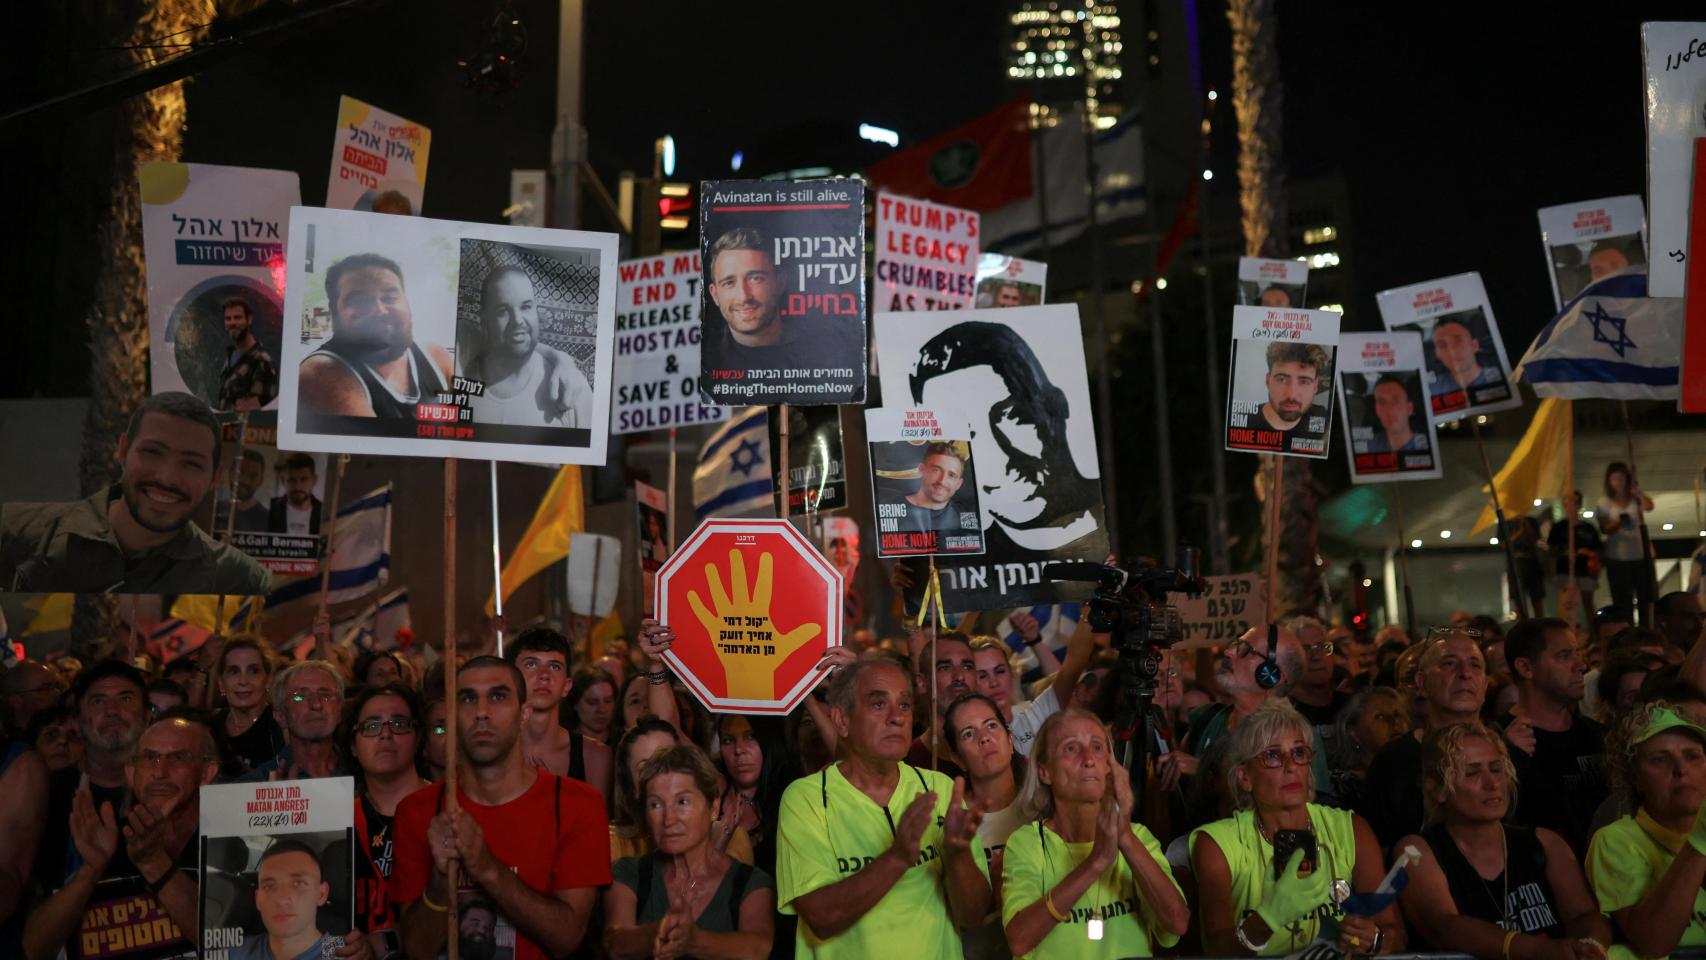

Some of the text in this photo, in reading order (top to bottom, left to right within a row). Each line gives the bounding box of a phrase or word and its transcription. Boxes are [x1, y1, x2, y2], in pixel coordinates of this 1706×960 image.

[350, 123, 381, 151] אהל
[385, 140, 416, 163] אלון
[340, 166, 377, 189] בחיים
[713, 189, 851, 203] Avinatan is still alive.
[881, 198, 977, 238] TRUMP'S
[172, 213, 280, 243] אלון אהל
[186, 245, 247, 262] שיחזור
[774, 236, 857, 266] אבינתן
[888, 230, 969, 265] LEGACY
[620, 260, 665, 283] WAR
[798, 263, 857, 292] עדיין
[877, 260, 976, 297] CRUMBLES
[633, 283, 676, 305] END
[780, 293, 858, 316] בחיים.
[617, 304, 692, 330] RELEASE
[620, 326, 702, 355] HOSTAG
[665, 354, 679, 373] &
[747, 370, 781, 380] הביתה
[784, 369, 811, 380] אותם
[813, 368, 853, 379] מחזירים
[454, 377, 483, 396] לעולם
[619, 380, 670, 406] SAVE
[713, 381, 854, 397] #BringThemHomeNow
[438, 393, 468, 406] לא עוד
[1230, 400, 1260, 414] BRING
[420, 406, 471, 421] זה עכשיו!
[621, 402, 722, 430] SOLDIERS
[1230, 413, 1249, 428] HIM
[1228, 430, 1256, 446] HOME
[1256, 432, 1283, 446] NOW!
[879, 503, 907, 518] BRING
[880, 518, 899, 532] HIM
[881, 531, 937, 549] HOME NOW!
[940, 566, 989, 590] אור
[724, 616, 741, 626] דמי
[720, 631, 773, 642] אחיך זועק
[763, 645, 775, 655] מן
[286, 787, 301, 801] מתן
[247, 799, 311, 814] MATAN ANGREST
[203, 927, 244, 950] BRING
